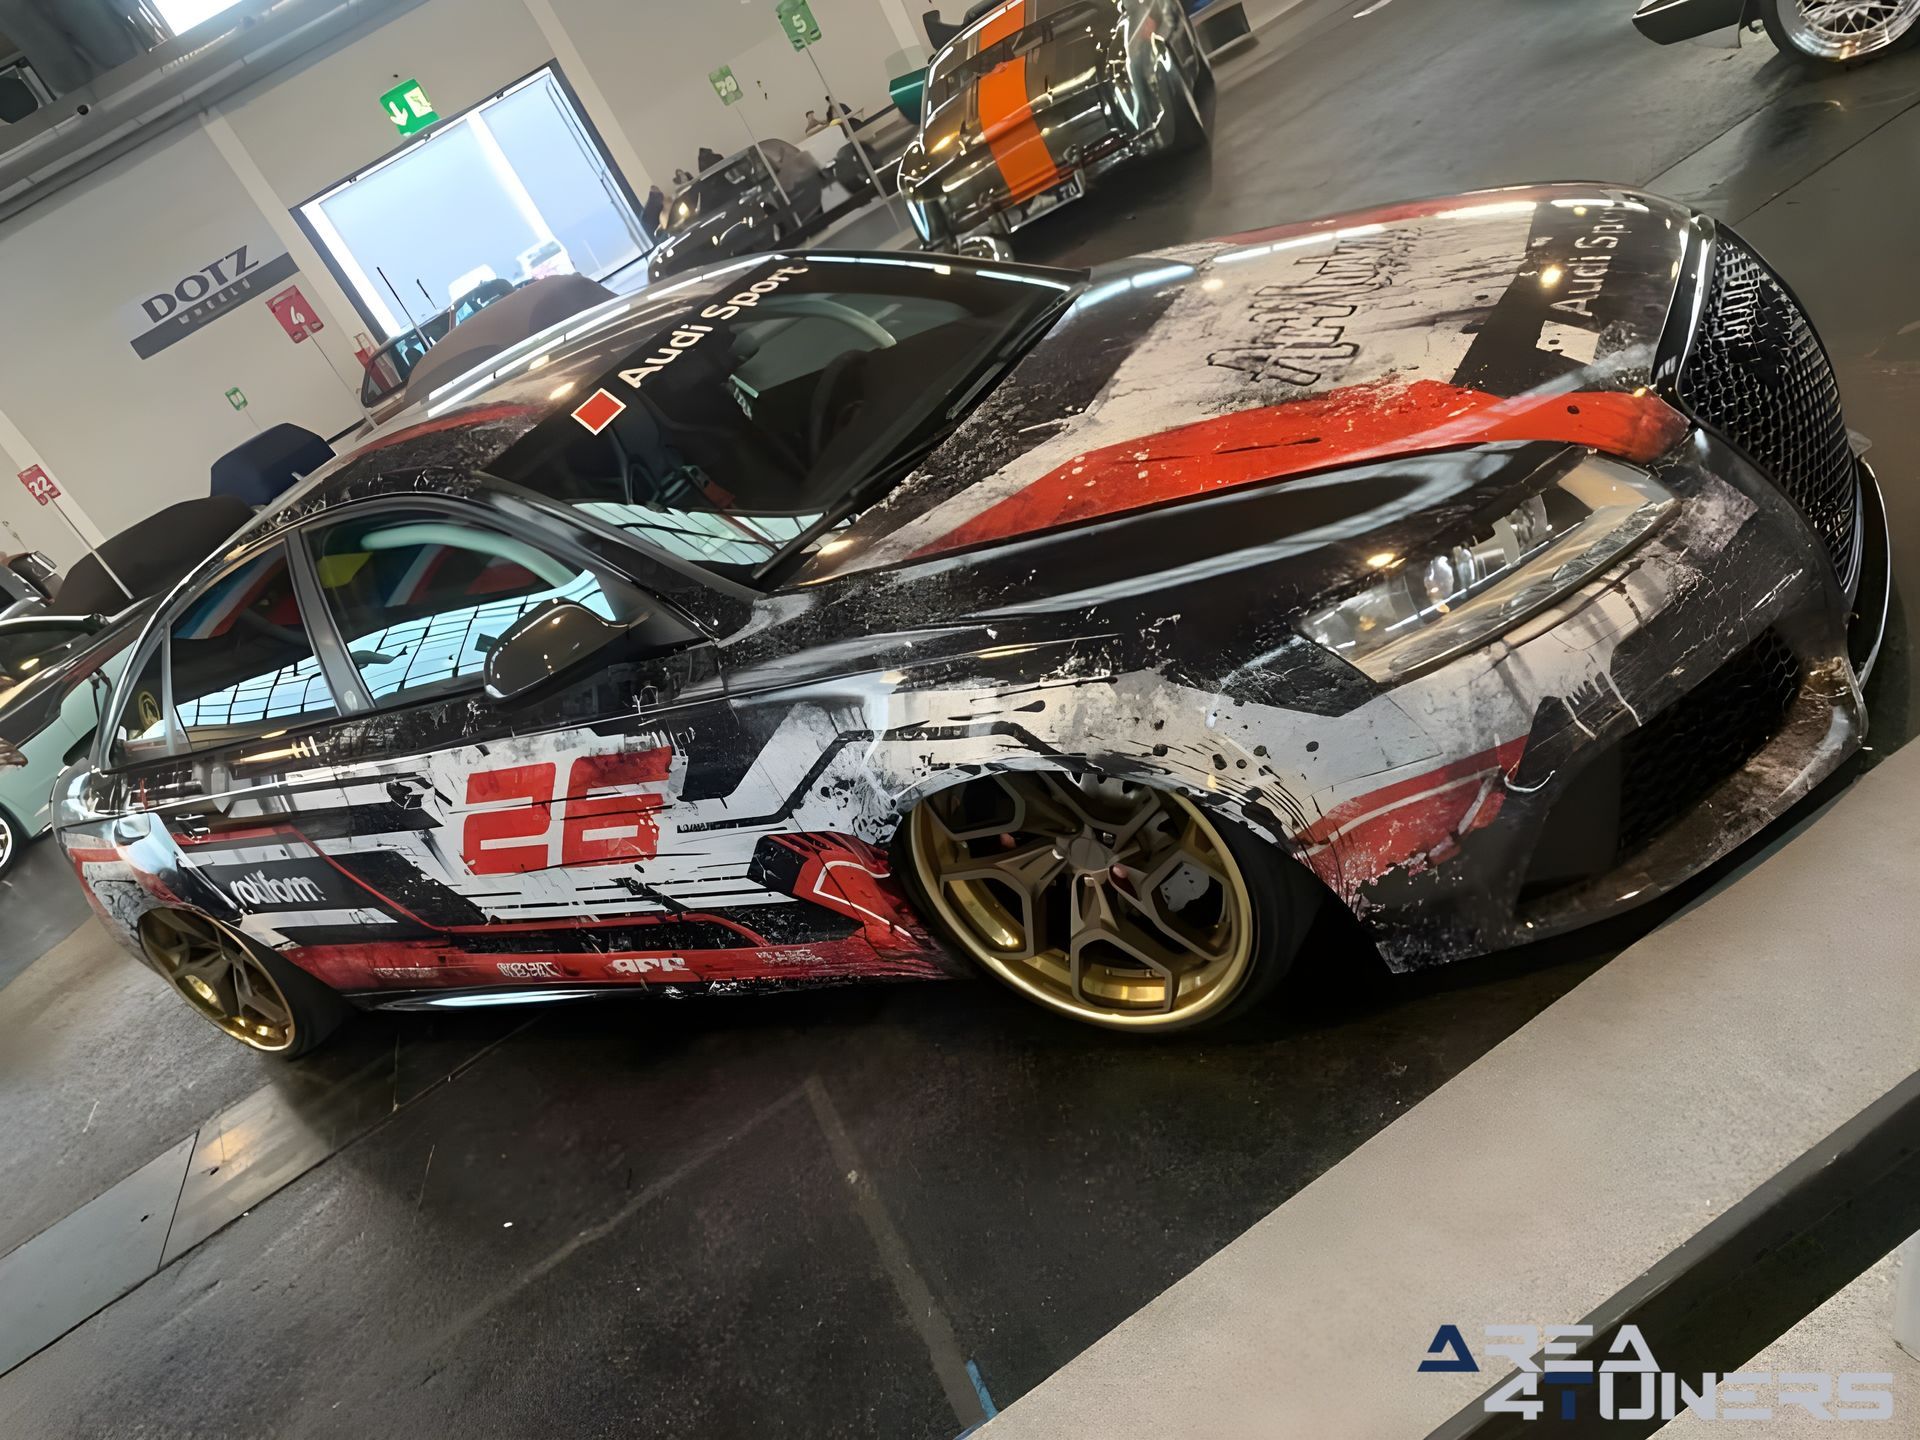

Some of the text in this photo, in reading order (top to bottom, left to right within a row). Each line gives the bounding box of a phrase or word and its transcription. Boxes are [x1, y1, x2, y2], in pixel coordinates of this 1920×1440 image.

[792, 14, 807, 33] 5
[141, 245, 259, 323] DOTZ
[1549, 256, 1612, 316] Audi
[618, 266, 809, 389] Audi Sport
[29, 476, 53, 497] 22
